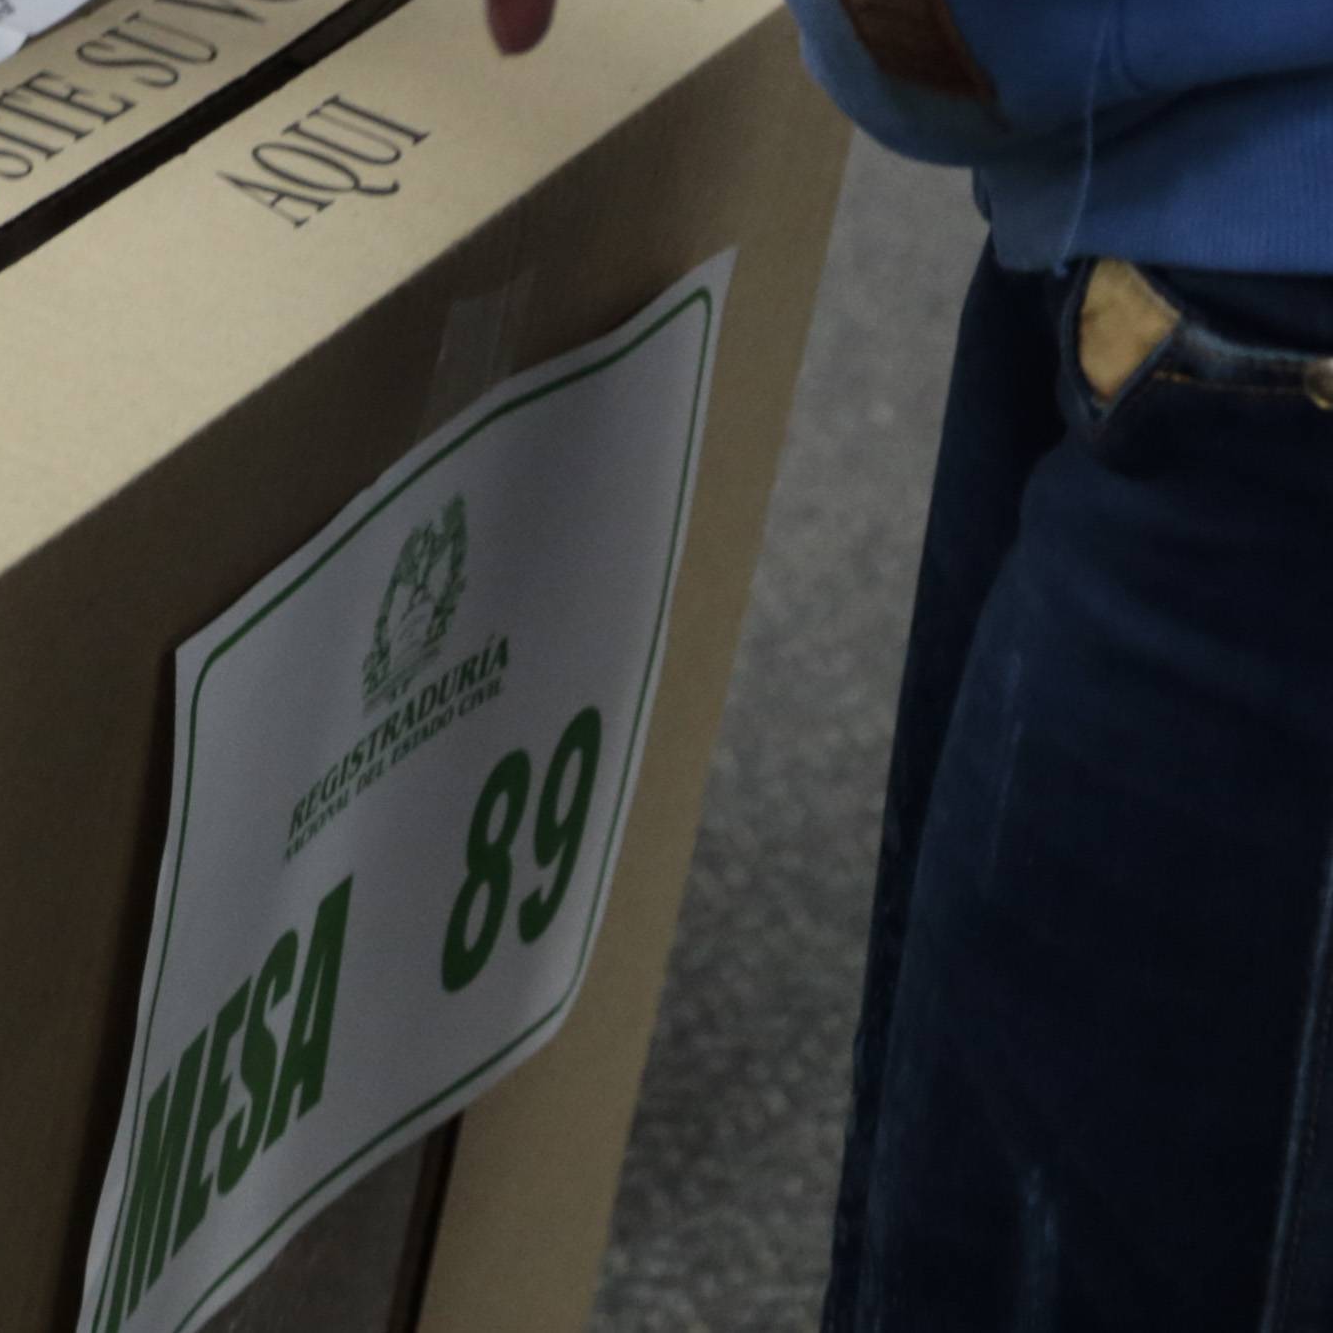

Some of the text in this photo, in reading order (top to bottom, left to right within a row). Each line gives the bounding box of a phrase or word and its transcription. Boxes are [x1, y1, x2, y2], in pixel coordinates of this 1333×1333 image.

[75, 15, 219, 90] SU
[217, 94, 431, 229] AQUI
[287, 632, 510, 844] REGISTRADURÍA
[441, 705, 602, 994] 89
[104, 872, 354, 1333] MESA
